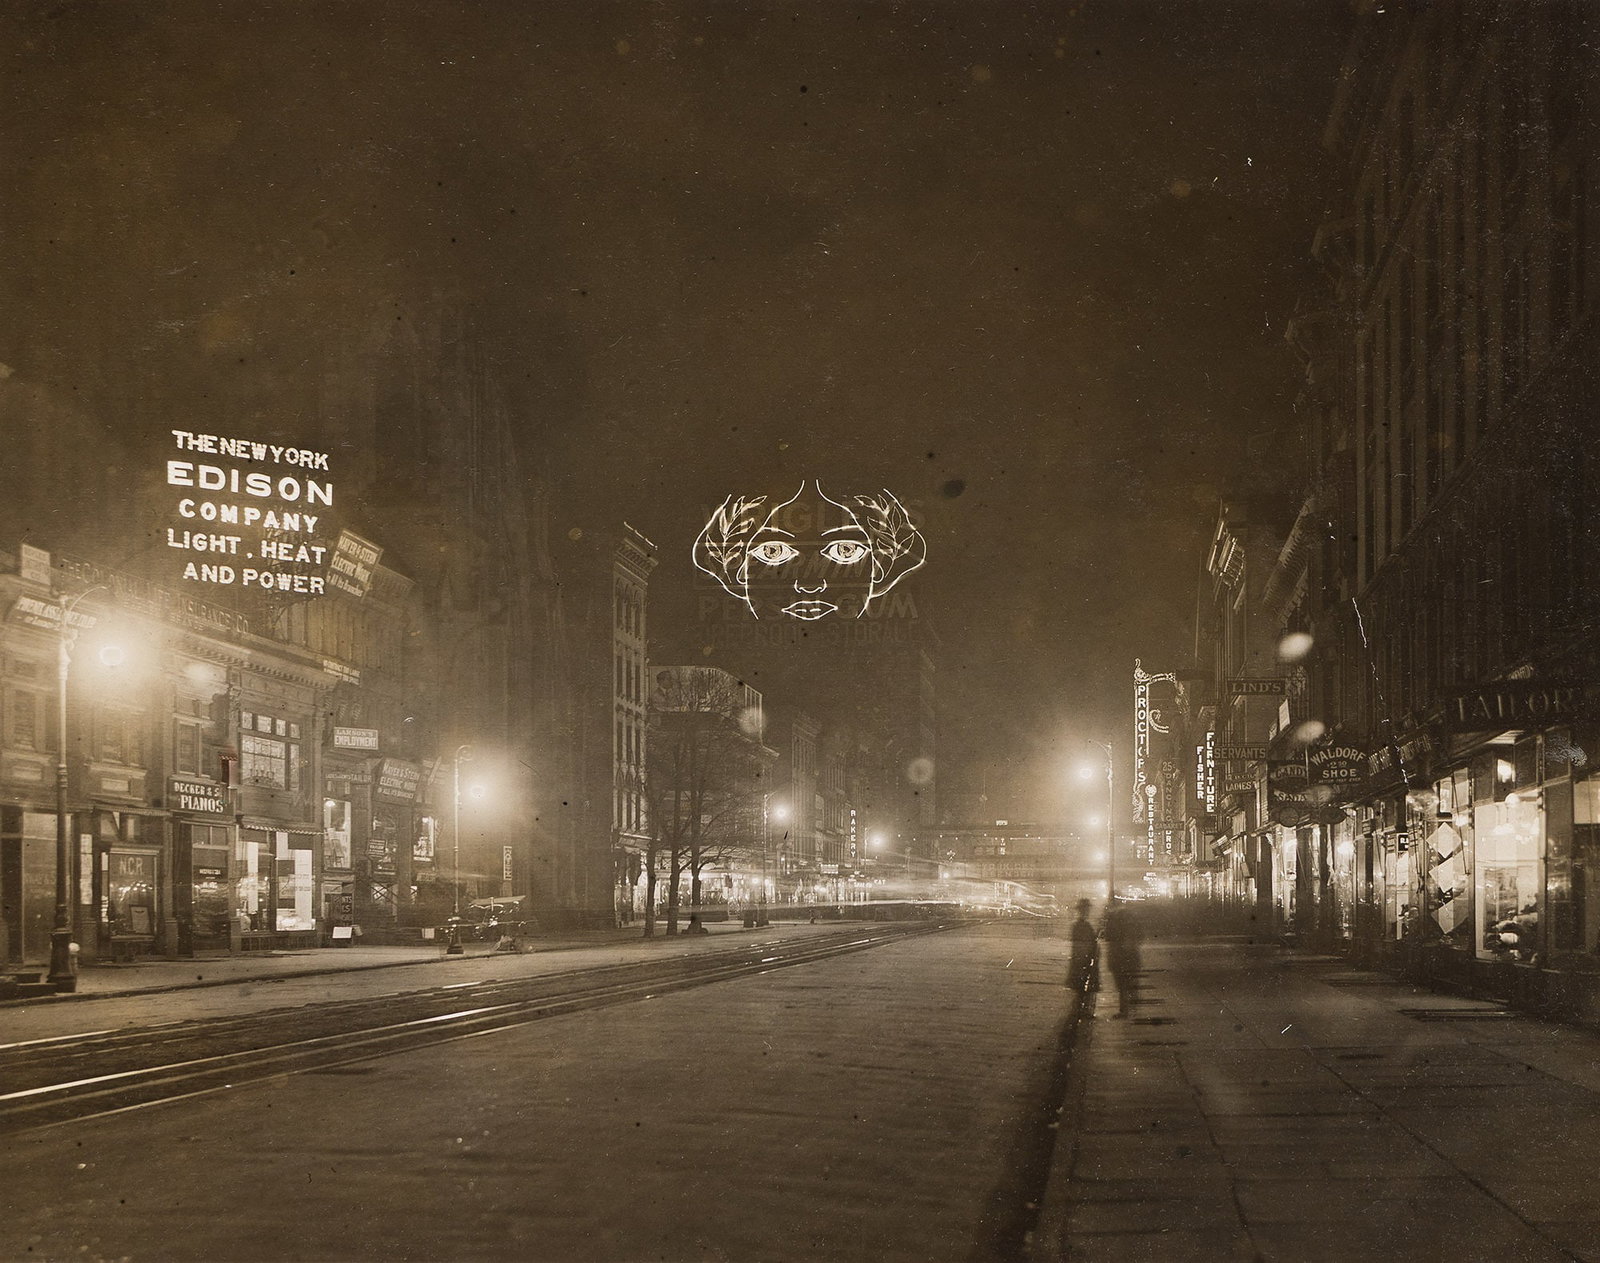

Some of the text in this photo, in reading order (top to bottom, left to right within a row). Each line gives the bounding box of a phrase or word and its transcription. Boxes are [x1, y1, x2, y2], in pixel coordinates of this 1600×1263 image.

[172, 430, 329, 471] THE NEW YORK
[167, 460, 333, 506] EDISON
[178, 498, 319, 534] COMPANY
[261, 539, 326, 565] HEAT
[183, 561, 325, 594] AND POWER
[1231, 682, 1280, 693] LIND'S
[1214, 747, 1266, 759] SERVANTS
[1310, 747, 1366, 766] WALDORF
[1196, 746, 1204, 800] FISHER
[1206, 732, 1215, 813] FURNITURE
[1322, 768, 1357, 779] SHOE
[174, 782, 206, 796] DECKER
[207, 786, 213, 797] &
[180, 794, 224, 813] PIANOS
